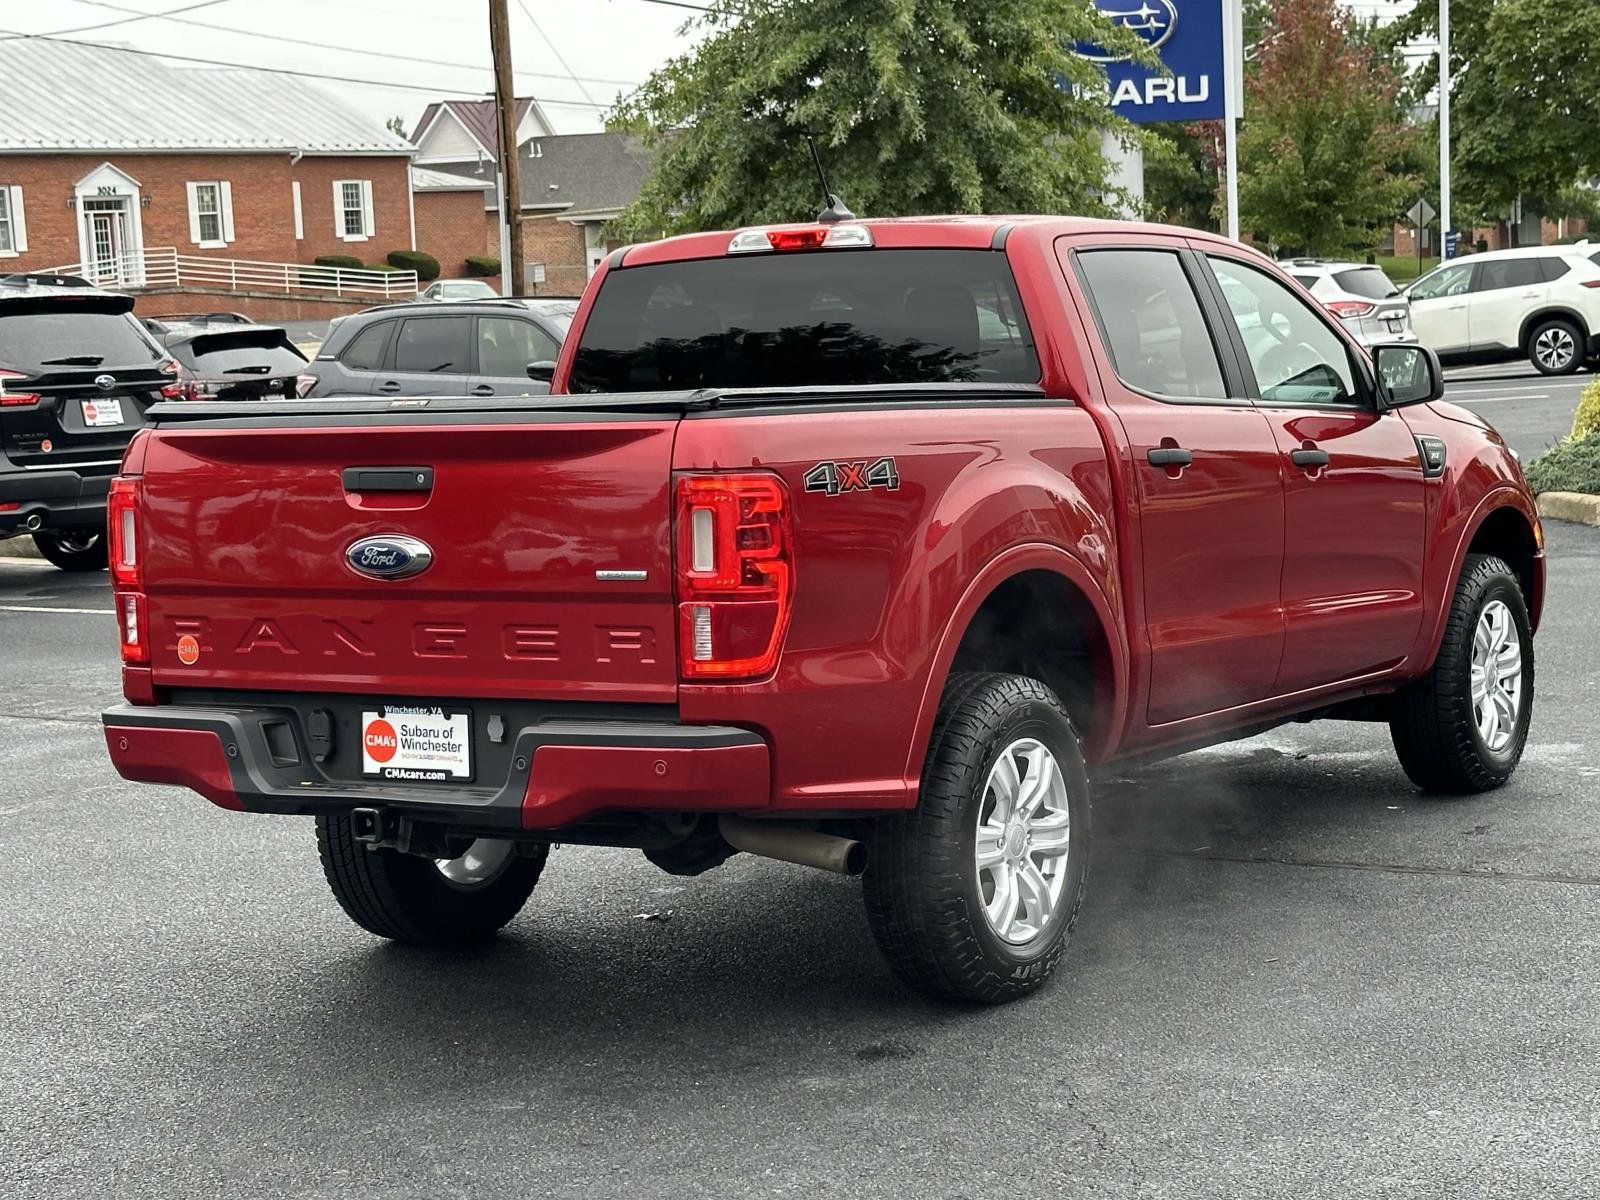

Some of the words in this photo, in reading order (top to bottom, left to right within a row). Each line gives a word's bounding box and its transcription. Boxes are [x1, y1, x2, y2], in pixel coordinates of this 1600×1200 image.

[361, 546, 397, 566] Ford
[384, 705, 430, 715] Winchester,
[431, 706, 443, 715] VA
[400, 724, 440, 738] Subaru
[442, 727, 454, 739] of
[366, 735, 396, 747] CMA's
[400, 738, 462, 753] Winchester
[384, 768, 446, 780] CMAcars.com
